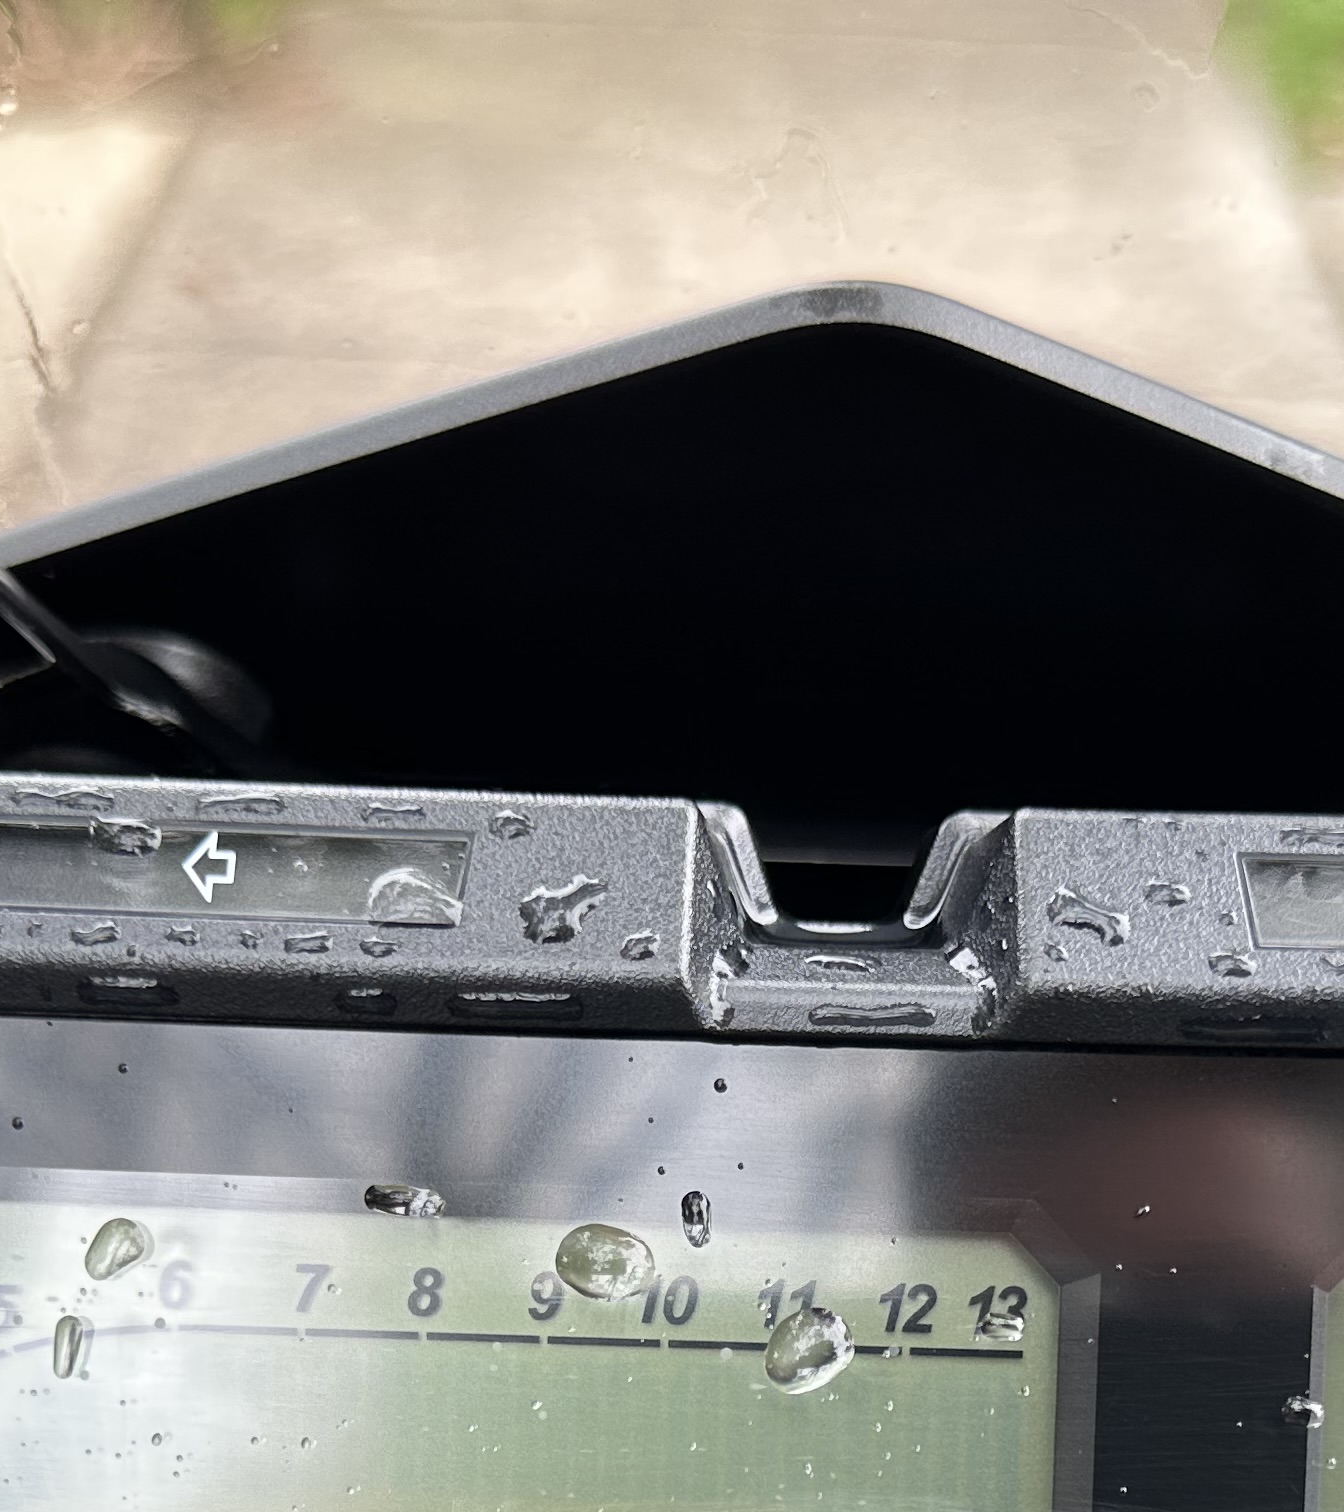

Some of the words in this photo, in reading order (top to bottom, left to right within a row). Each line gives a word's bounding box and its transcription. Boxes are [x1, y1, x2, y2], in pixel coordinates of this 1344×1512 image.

[158, 1260, 193, 1309] 6
[295, 1263, 333, 1313] 7
[407, 1267, 444, 1317] 8
[528, 1271, 563, 1321] 9
[641, 1274, 698, 1326] 10
[758, 1280, 818, 1328] 11
[879, 1283, 938, 1333] 12
[969, 1286, 1028, 1341] 13
